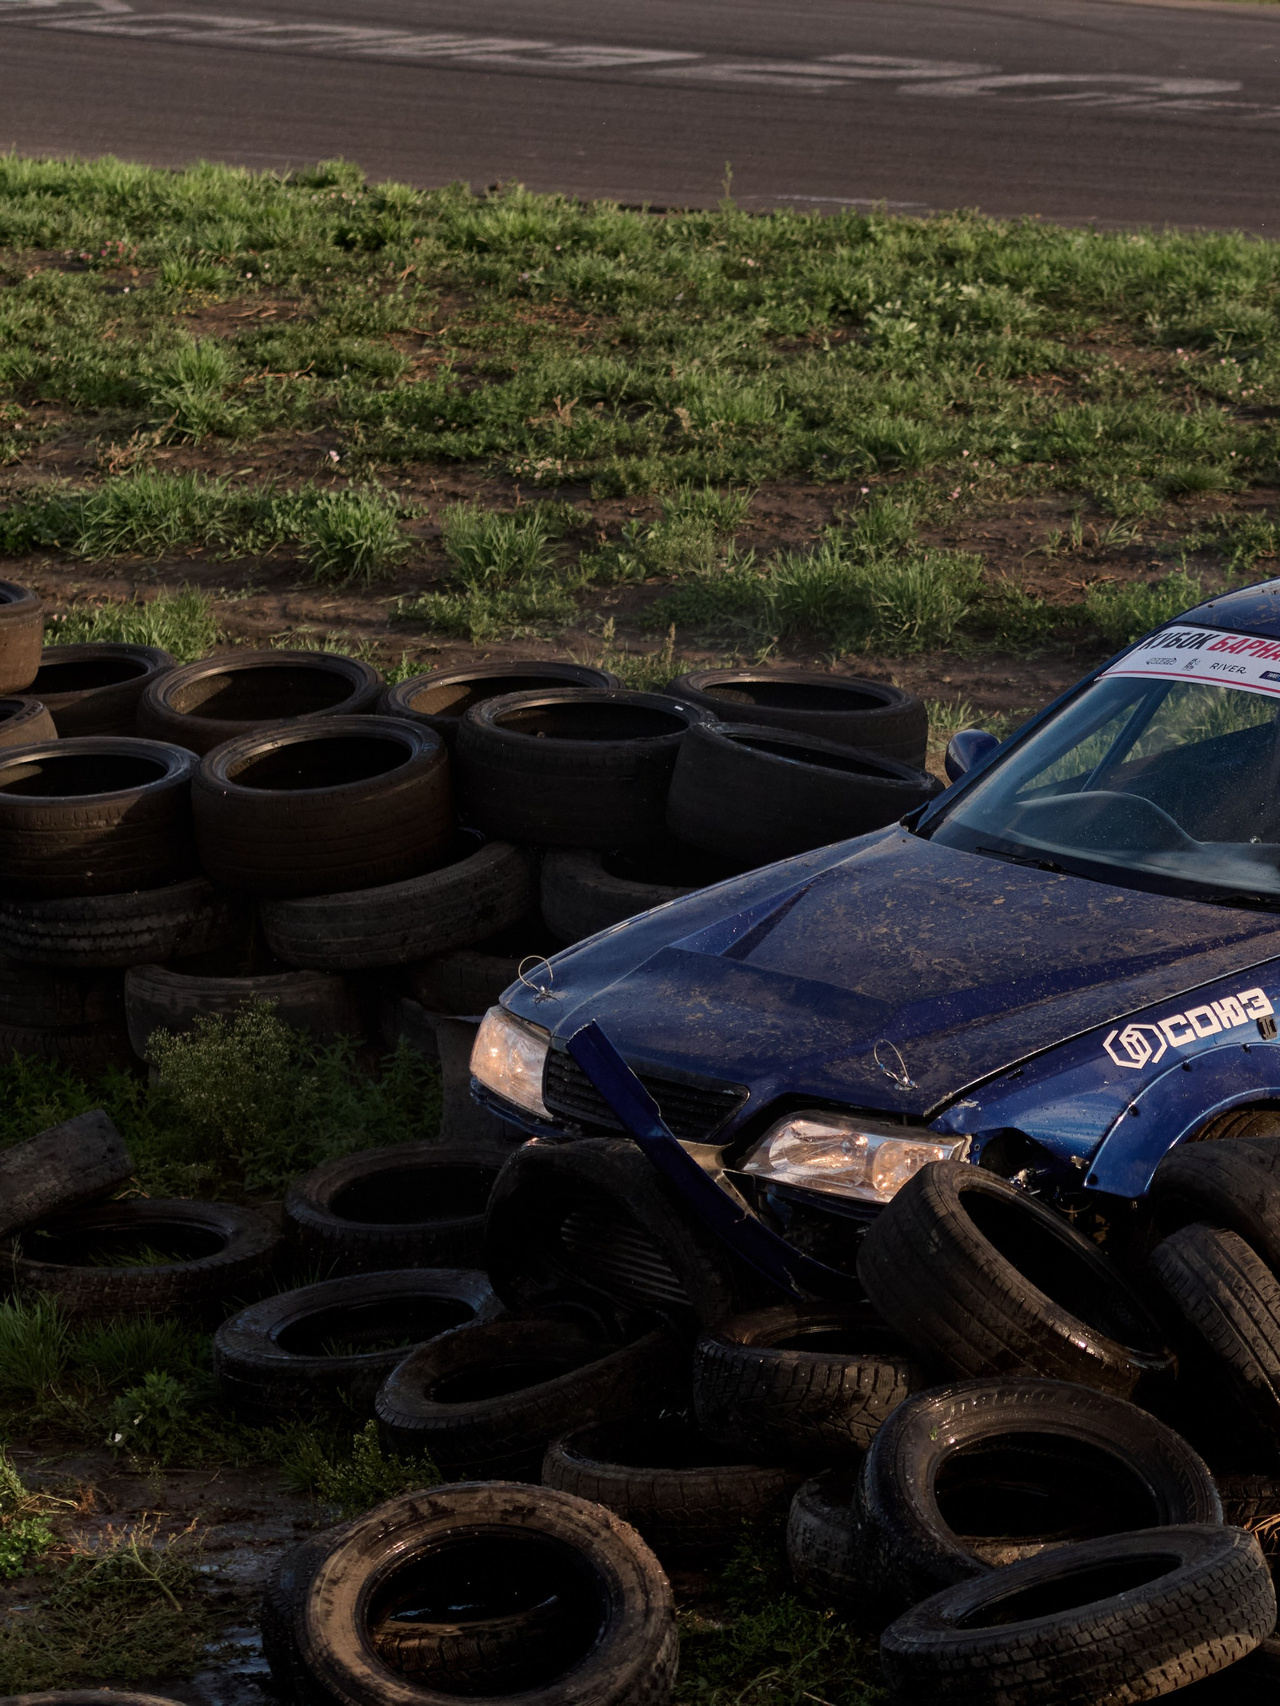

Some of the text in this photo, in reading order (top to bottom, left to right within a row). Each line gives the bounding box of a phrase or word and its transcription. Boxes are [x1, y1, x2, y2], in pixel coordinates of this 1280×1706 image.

[1139, 632, 1221, 651] КУБОК
[1209, 662, 1247, 675] RIVER
[1157, 987, 1275, 1048] СОЮЗ
